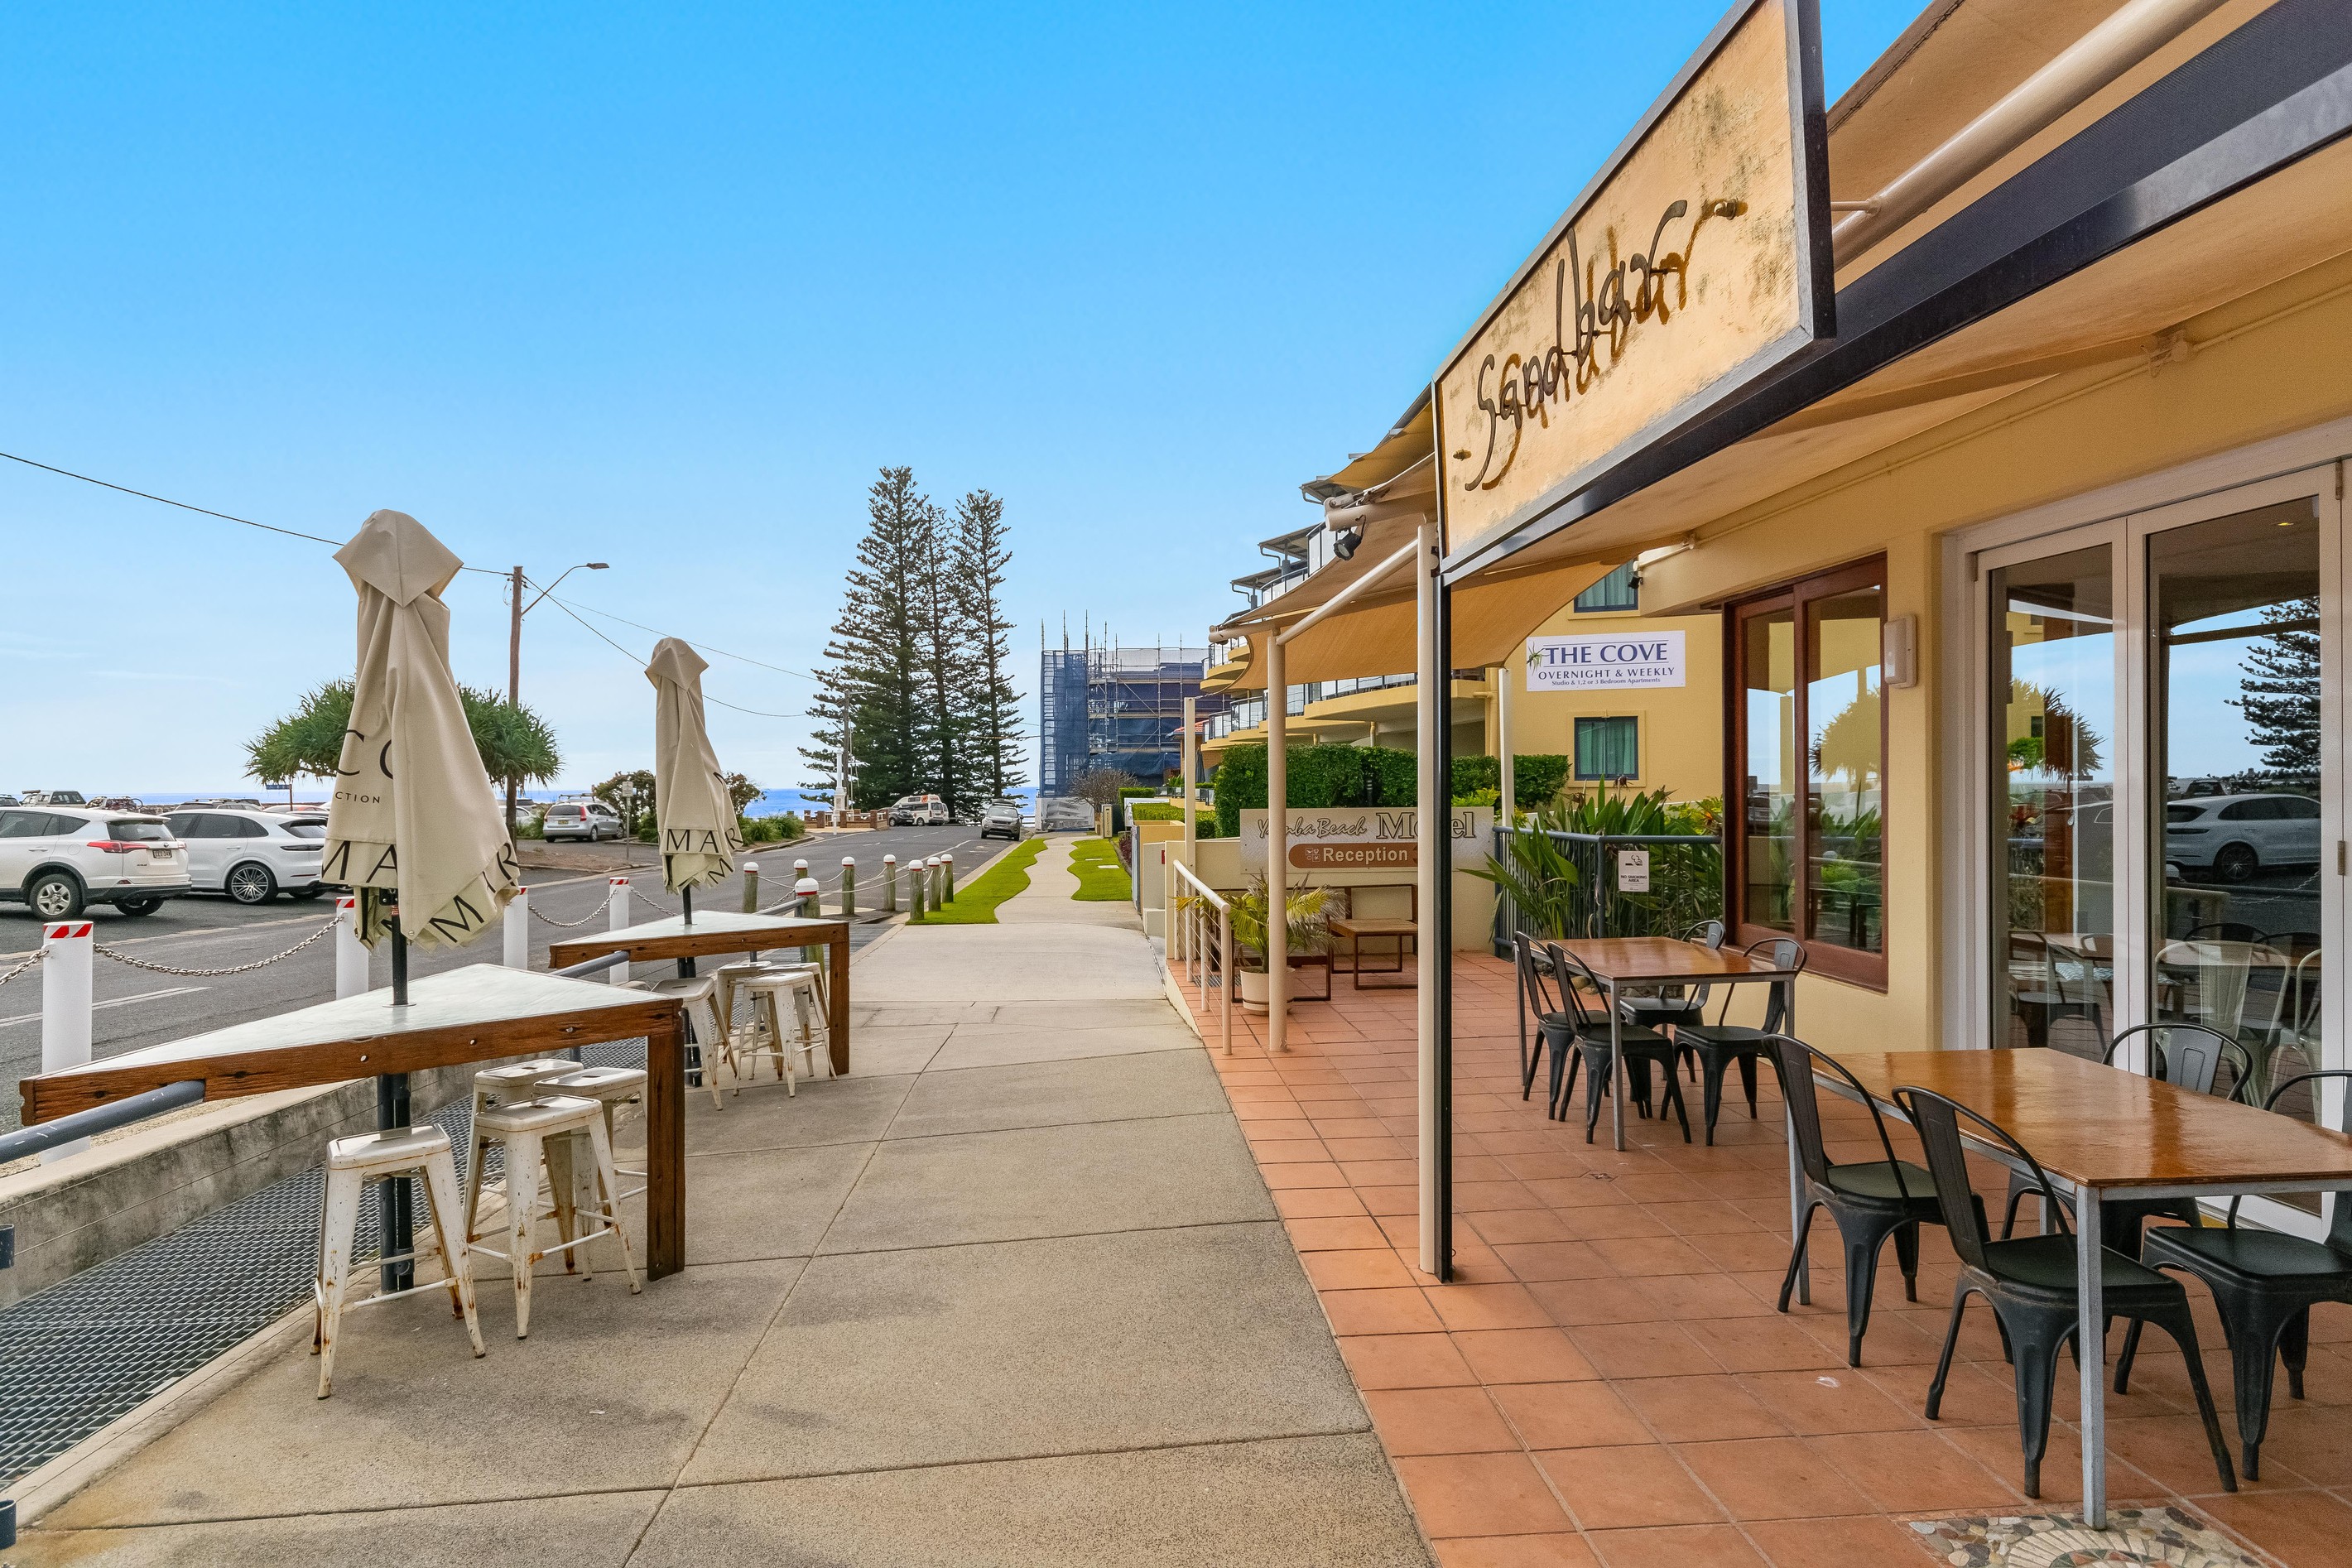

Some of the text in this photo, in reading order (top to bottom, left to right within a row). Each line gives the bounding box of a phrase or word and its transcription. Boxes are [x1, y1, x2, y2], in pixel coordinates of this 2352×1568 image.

[1545, 642, 1667, 664] THE COVE
[1538, 667, 1675, 680] OVERNIGHT & WEEKLY
[1258, 811, 1476, 839] Yba Beach Mel
[1323, 846, 1408, 865] Reception
